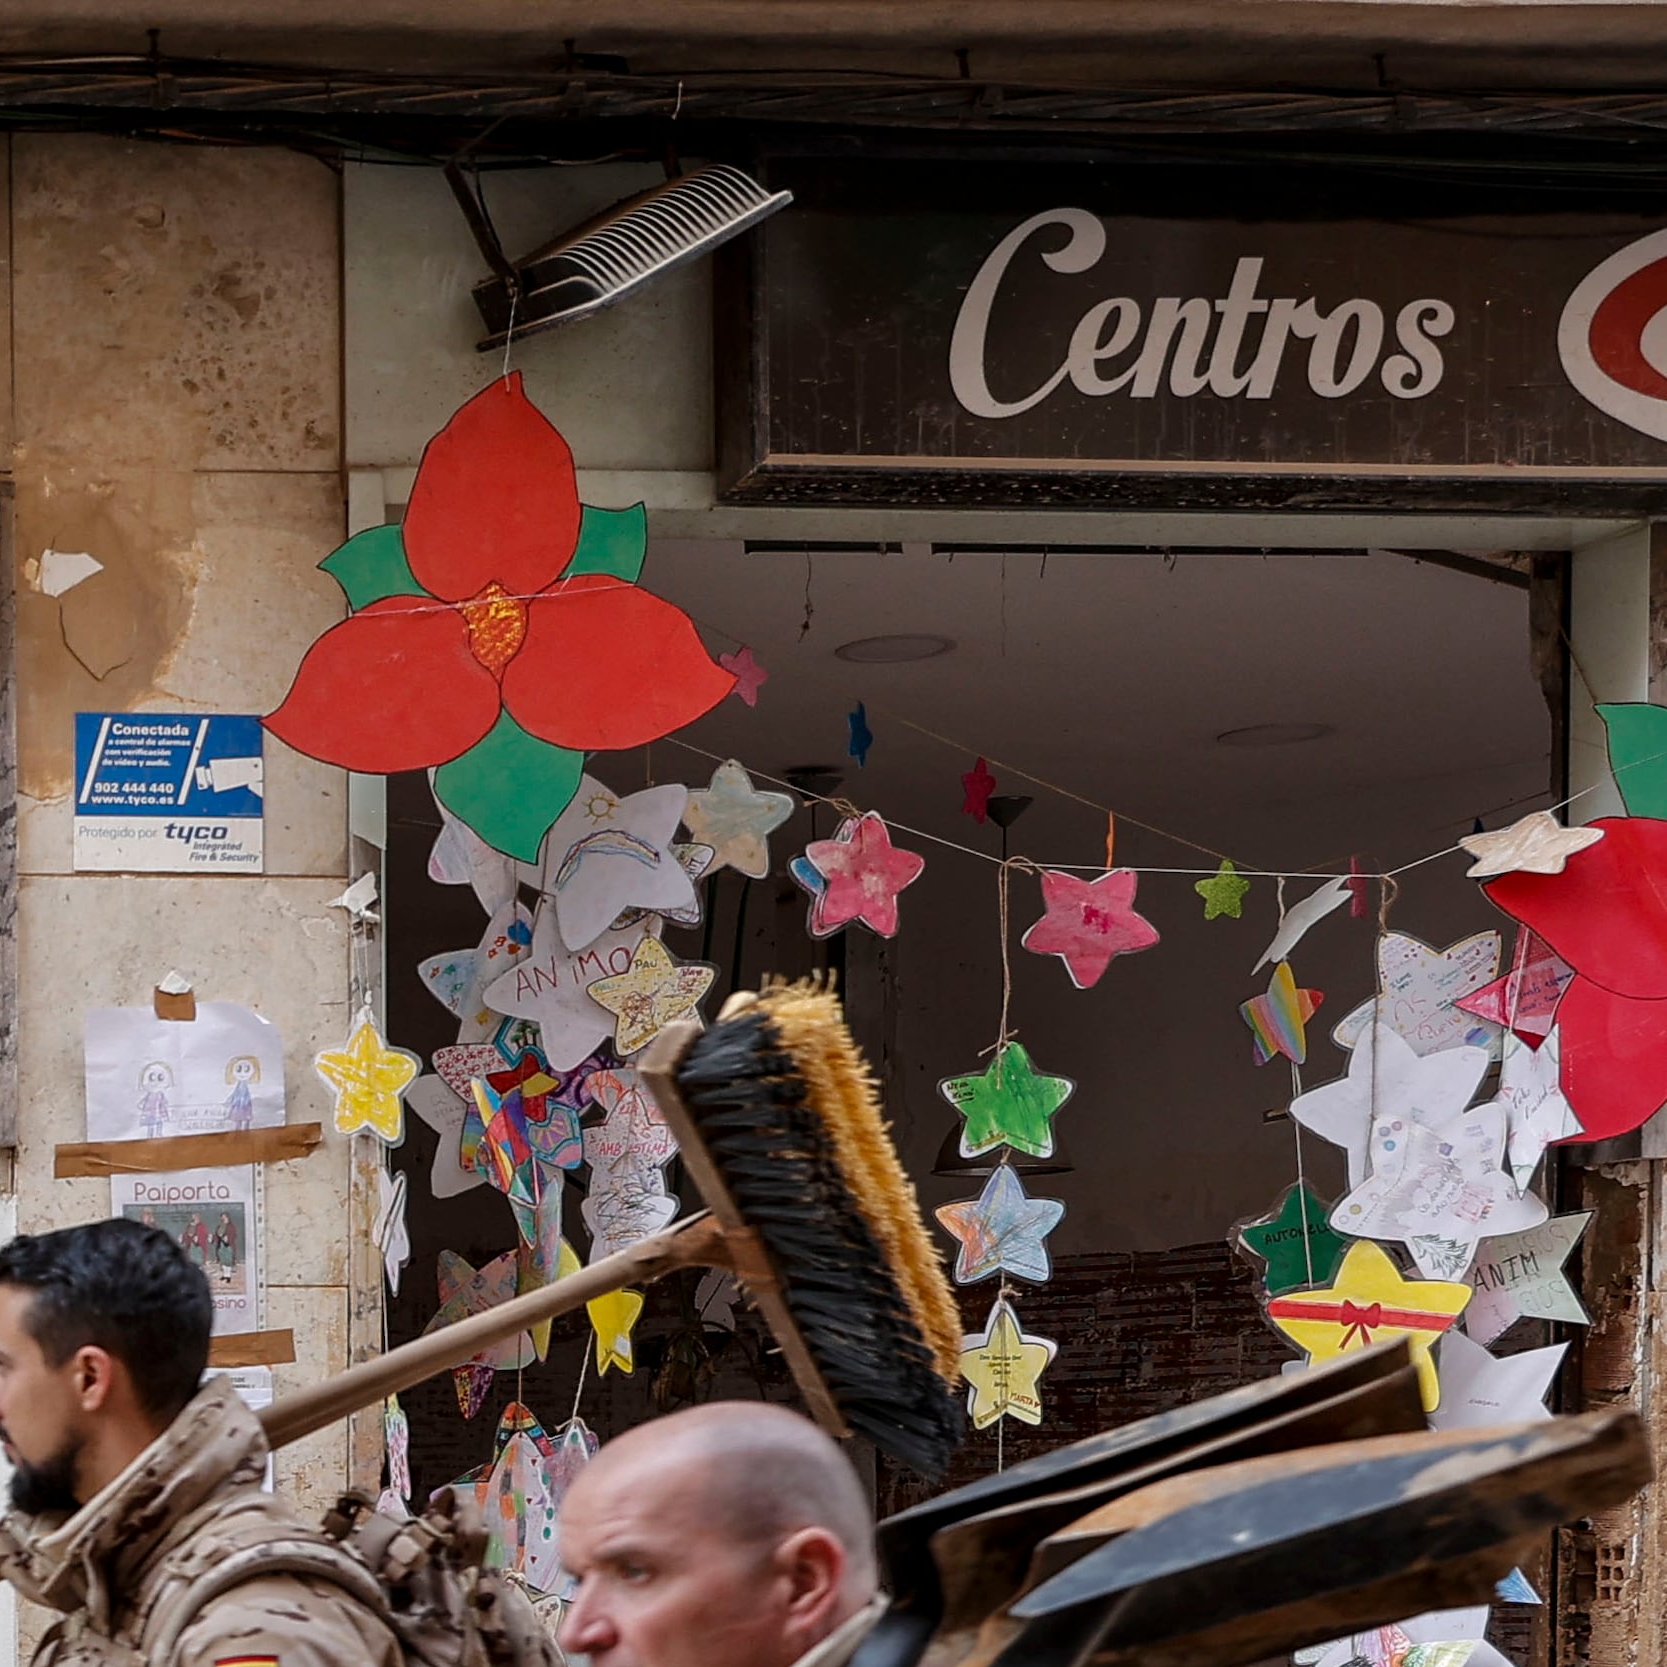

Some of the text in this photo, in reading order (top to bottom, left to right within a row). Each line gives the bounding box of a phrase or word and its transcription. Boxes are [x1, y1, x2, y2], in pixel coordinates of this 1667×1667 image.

[948, 207, 1455, 419] Centros
[111, 722, 190, 737] Conectada
[94, 782, 175, 793] 902 444 440
[91, 794, 175, 806] www.tyco.es
[78, 826, 157, 841] Protegido por
[164, 823, 228, 845] tyco
[192, 842, 243, 852] Integrated
[189, 852, 260, 864] Fire & Security
[134, 1180, 230, 1204] Paiporta
